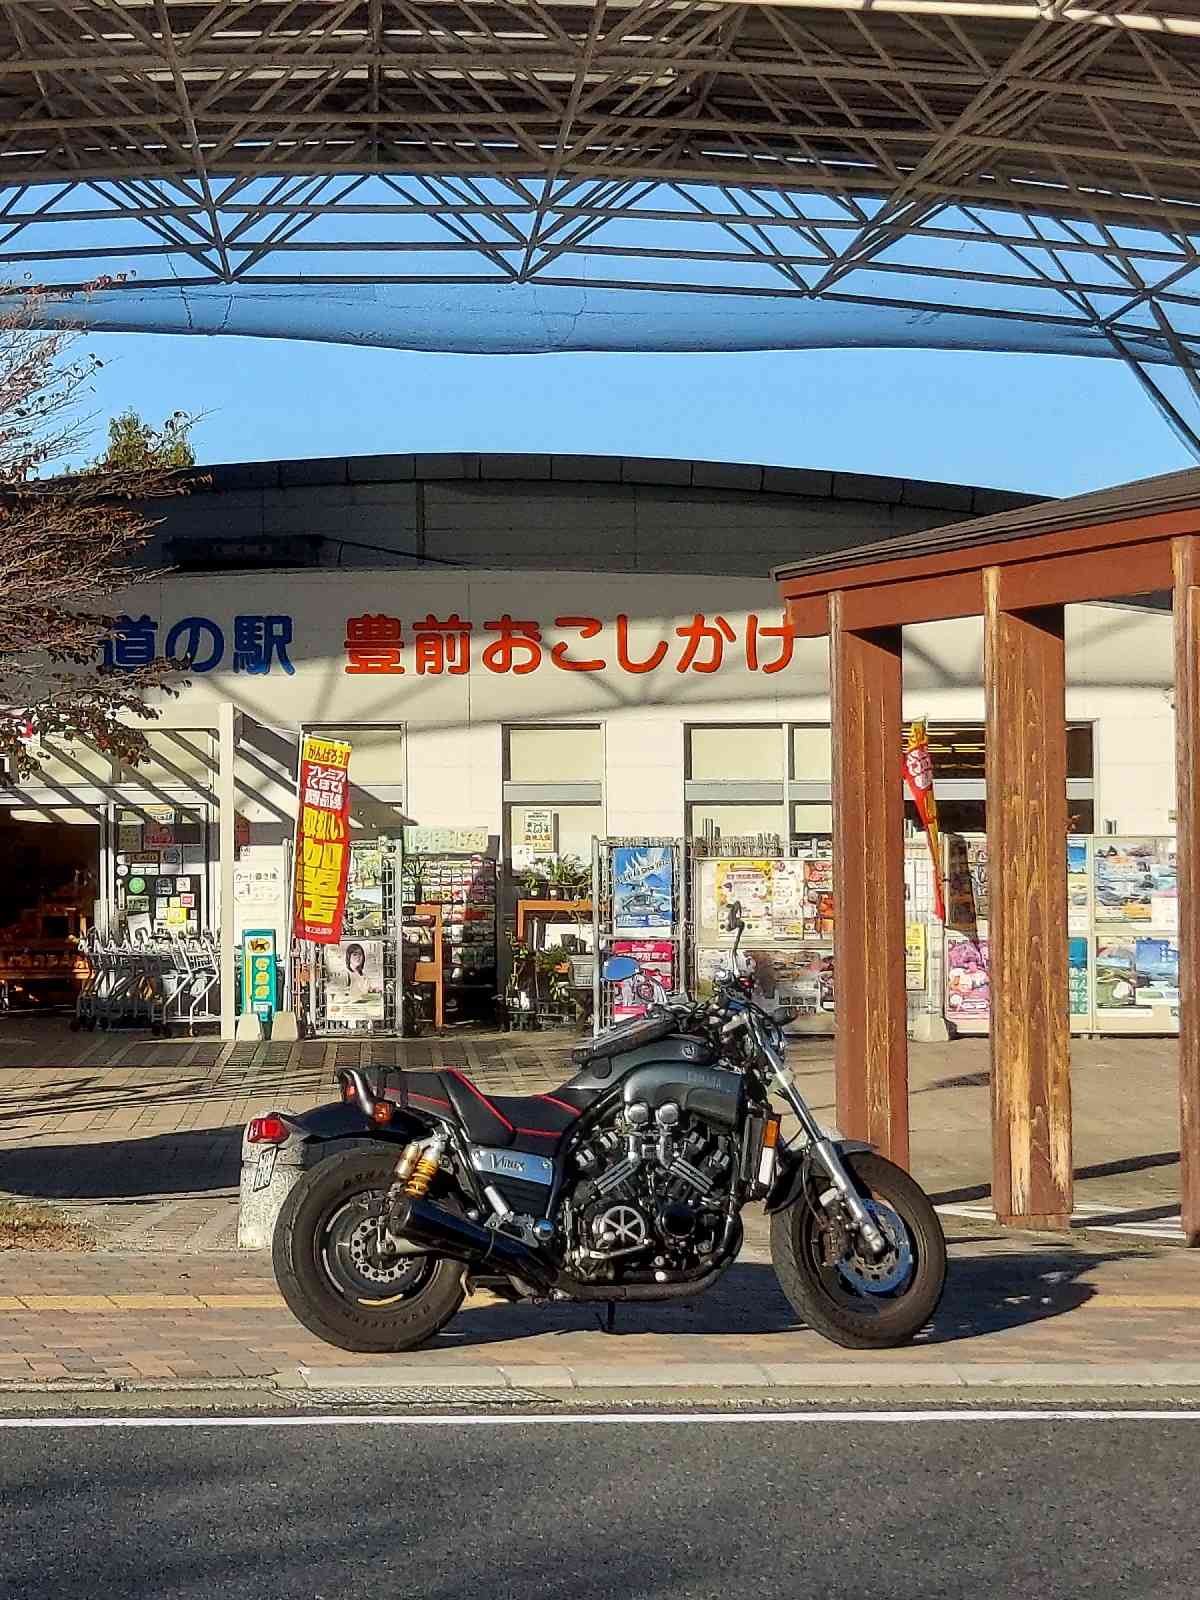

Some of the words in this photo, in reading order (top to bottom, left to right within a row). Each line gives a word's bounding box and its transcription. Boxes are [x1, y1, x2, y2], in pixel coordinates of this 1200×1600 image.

[99, 615, 296, 675] 道の駅
[343, 614, 796, 675] 豊前おこしかけ
